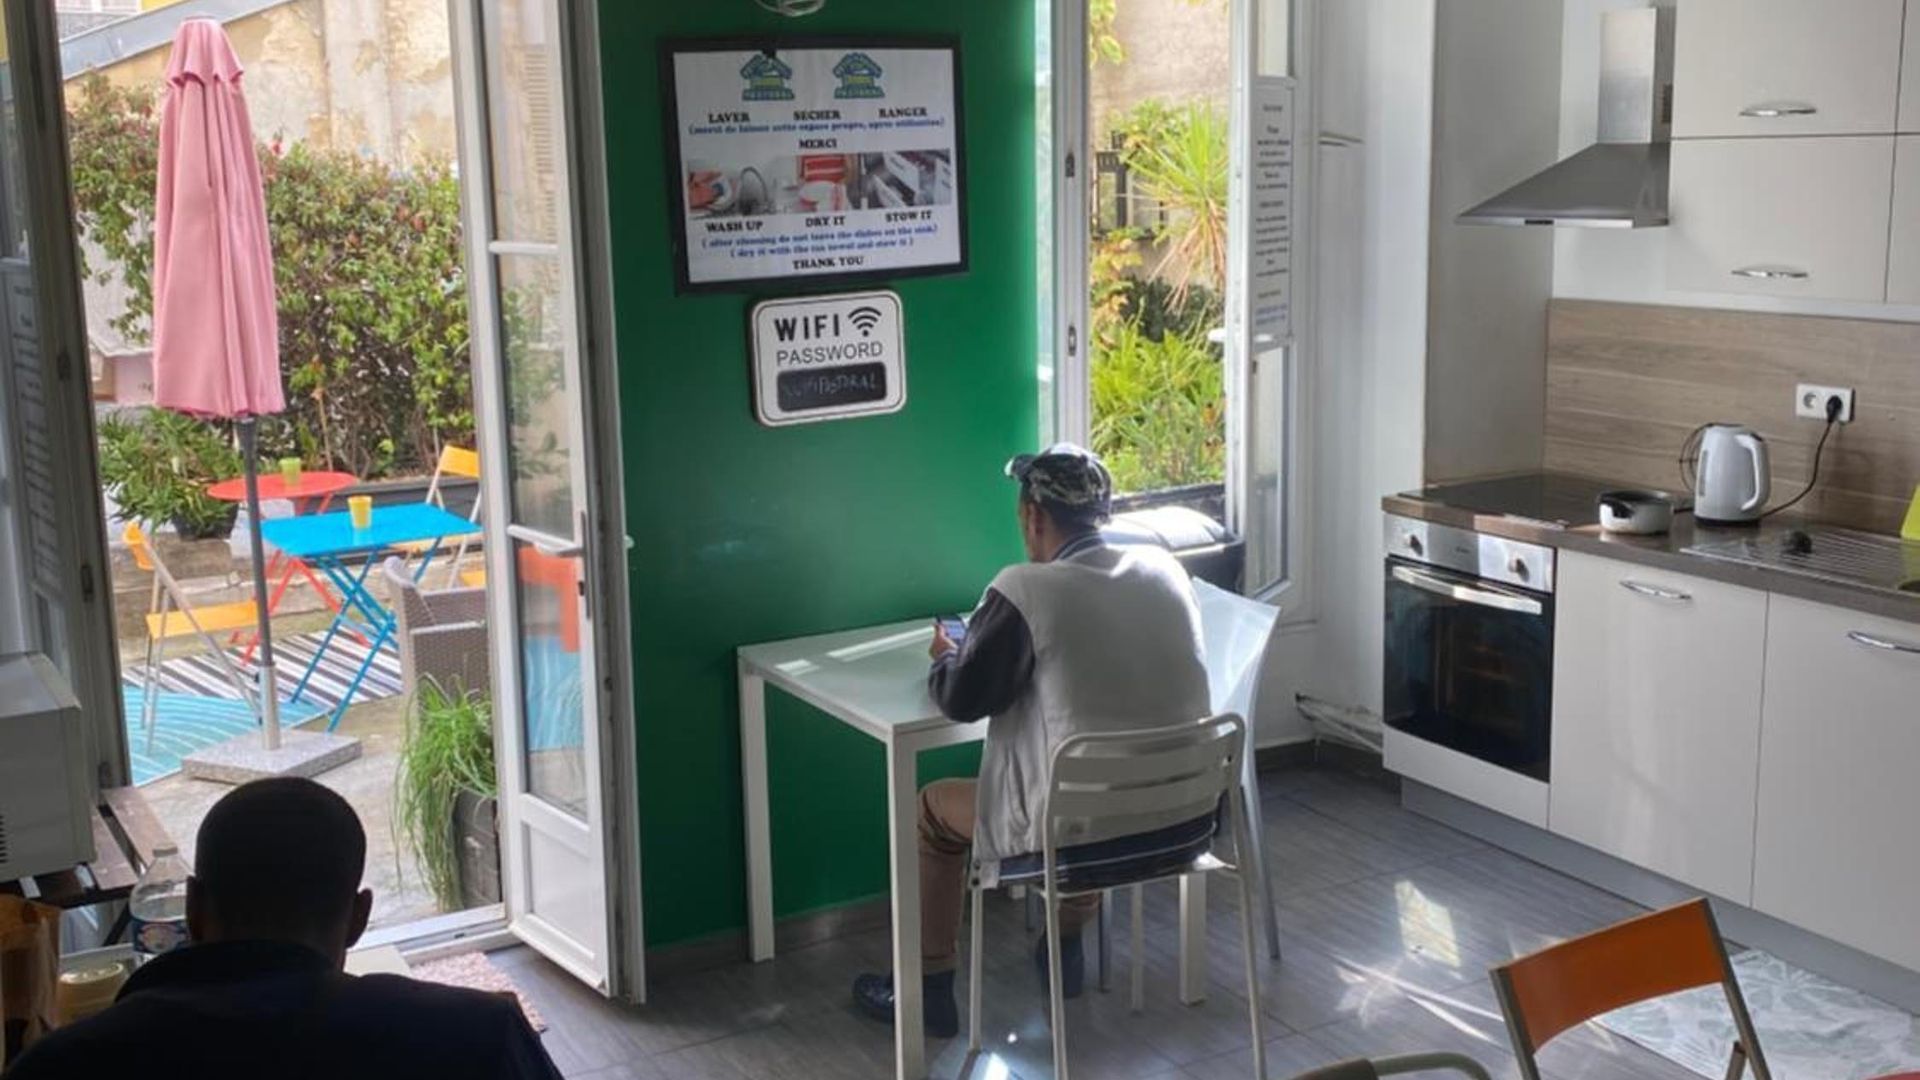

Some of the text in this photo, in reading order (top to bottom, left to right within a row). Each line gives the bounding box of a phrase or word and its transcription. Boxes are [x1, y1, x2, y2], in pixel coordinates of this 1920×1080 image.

[708, 112, 750, 123] LAVER
[793, 110, 841, 121] SECHER
[878, 107, 927, 118] RANGER
[799, 138, 837, 149] MERCI
[806, 216, 846, 228] DRY IT
[886, 210, 932, 223] STOW IT
[706, 220, 763, 232] WASH UP
[792, 256, 865, 270] THANK YOU
[774, 313, 839, 342] WIFI
[777, 341, 884, 366] PASSWORD
